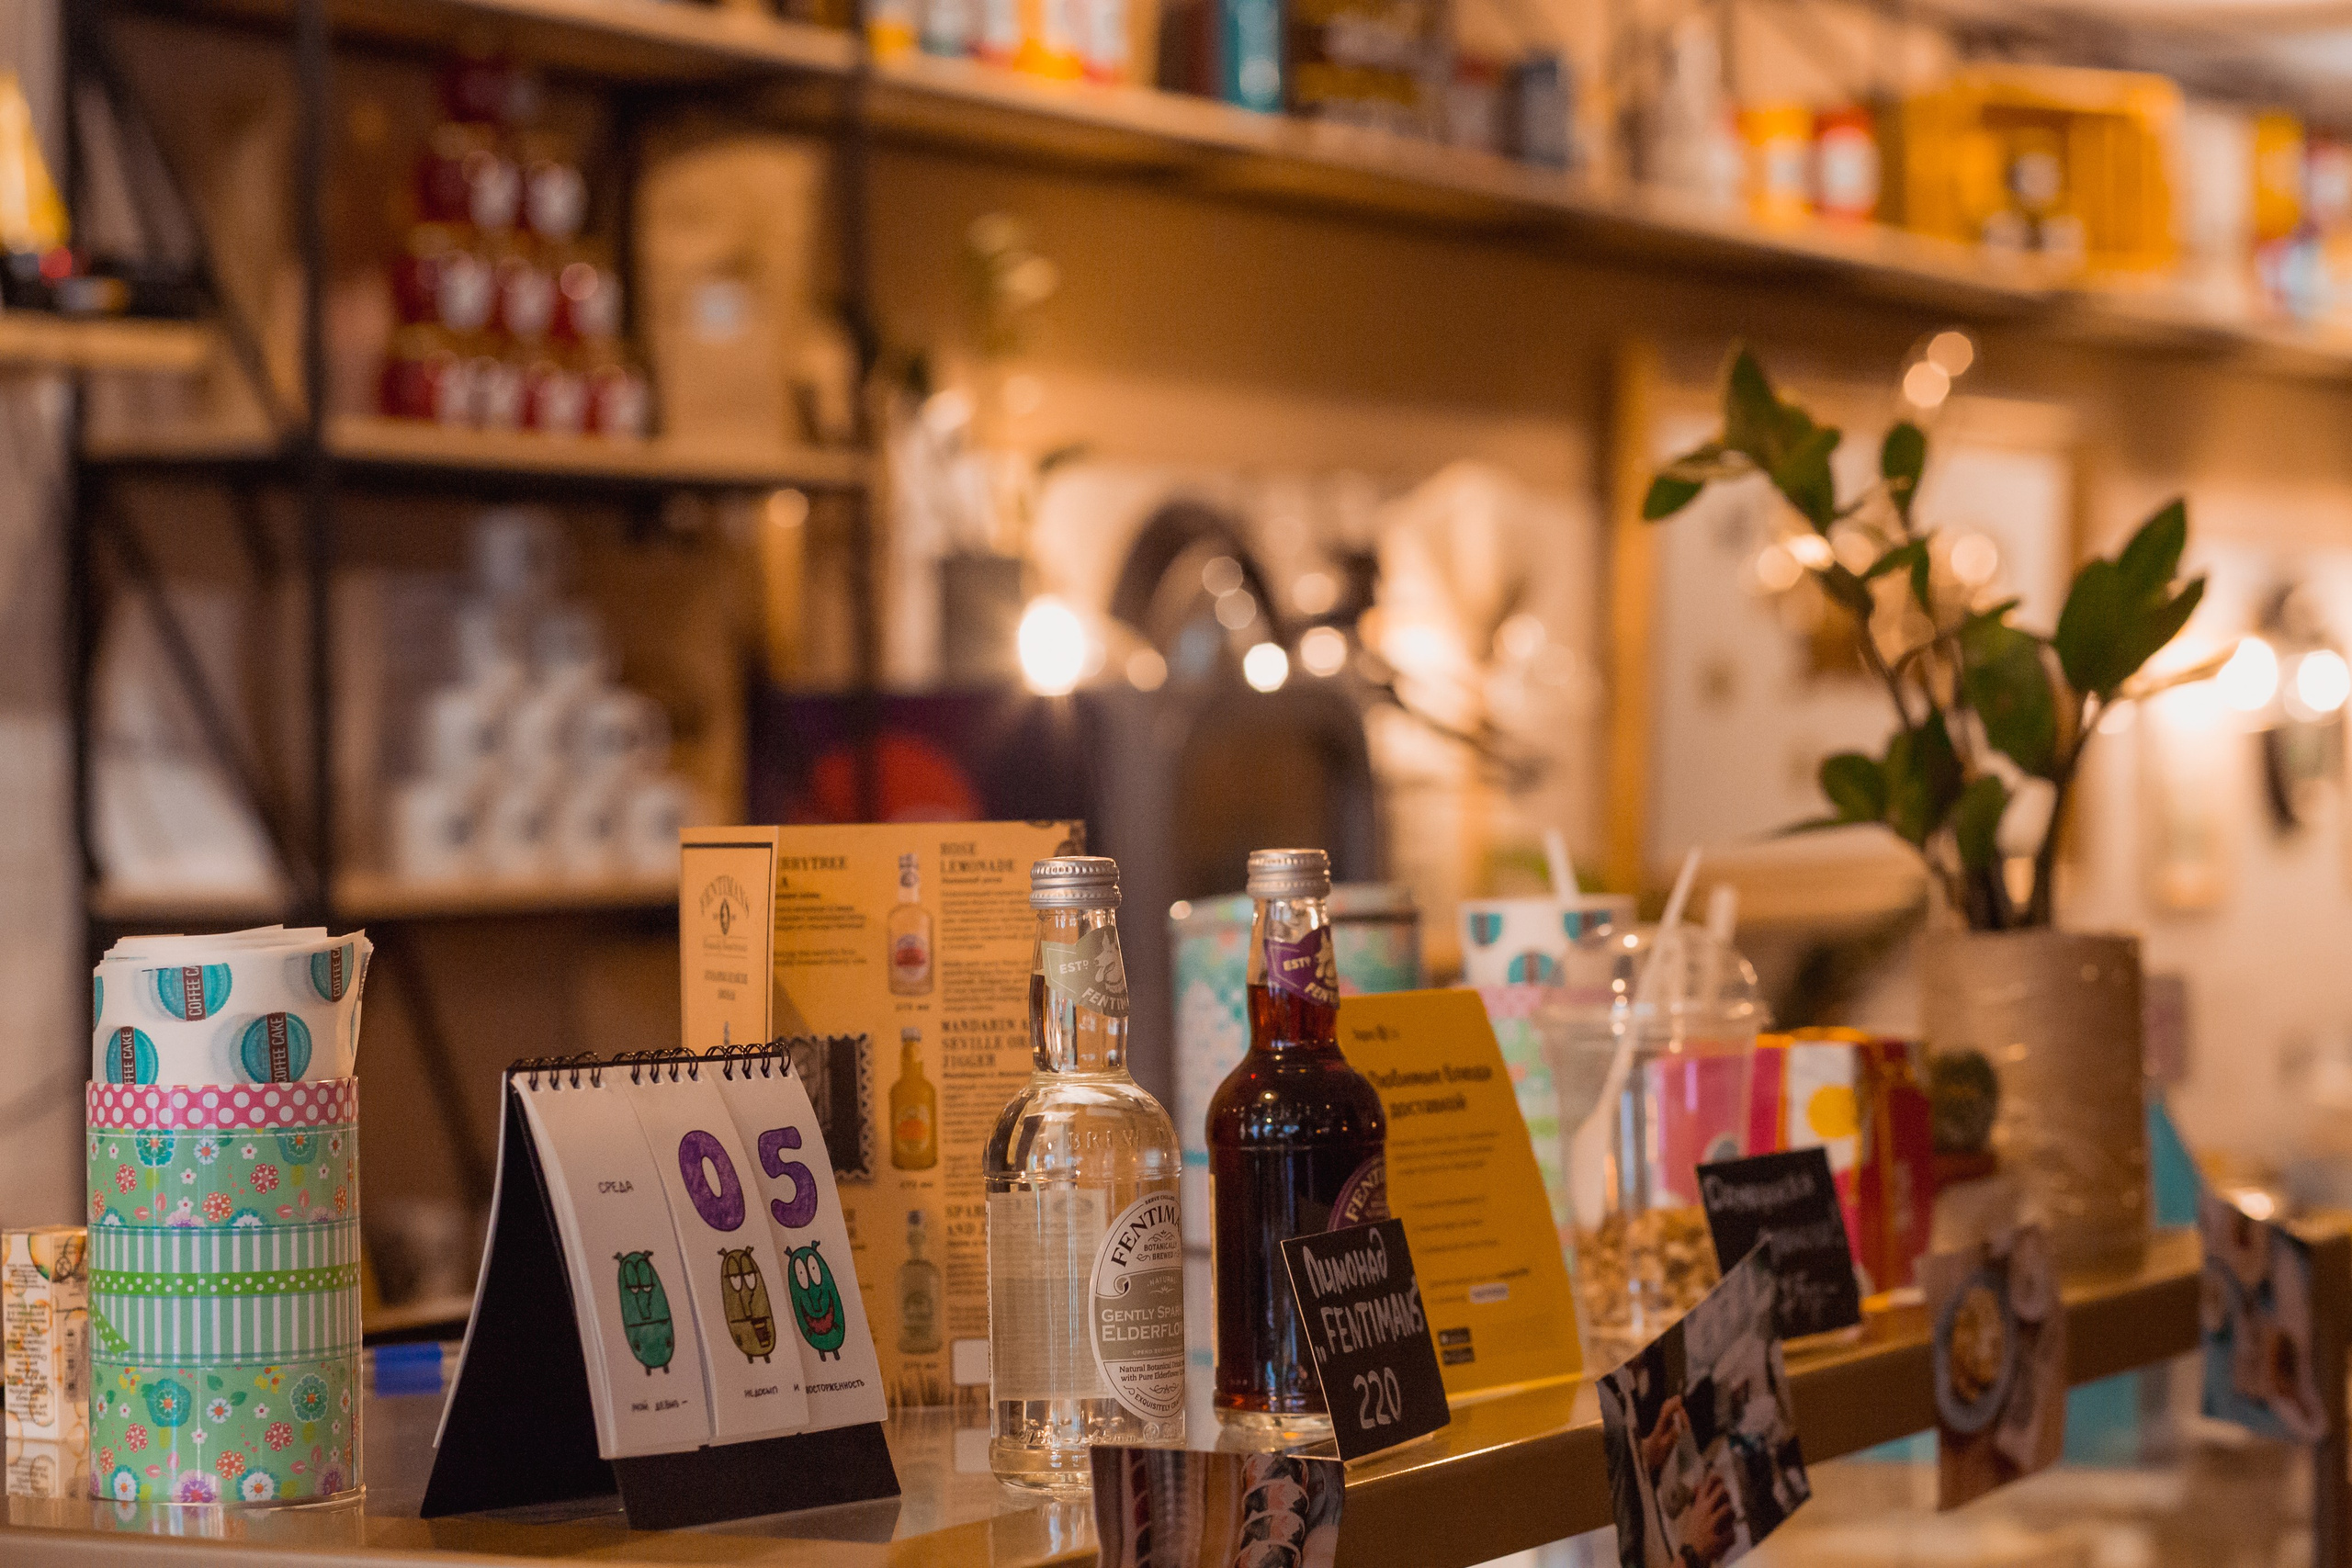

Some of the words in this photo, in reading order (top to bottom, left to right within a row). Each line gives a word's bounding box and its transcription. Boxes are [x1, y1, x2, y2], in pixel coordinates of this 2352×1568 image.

[333, 962, 342, 998] COFFEE
[187, 978, 204, 1017] COFFEE
[270, 1018, 285, 1045] CAKE
[121, 1032, 134, 1060] CAKE
[598, 1180, 634, 1193] СРЕДА
[1152, 1251, 1174, 1261] BREWED
[1102, 1309, 1155, 1323] GENTLY
[1119, 1364, 1146, 1373] Natural
[1121, 1373, 1137, 1382] with
[1139, 1372, 1154, 1382] Pure
[1135, 1394, 1170, 1412] EXQUISITELY
[1353, 1367, 1401, 1429] 220
